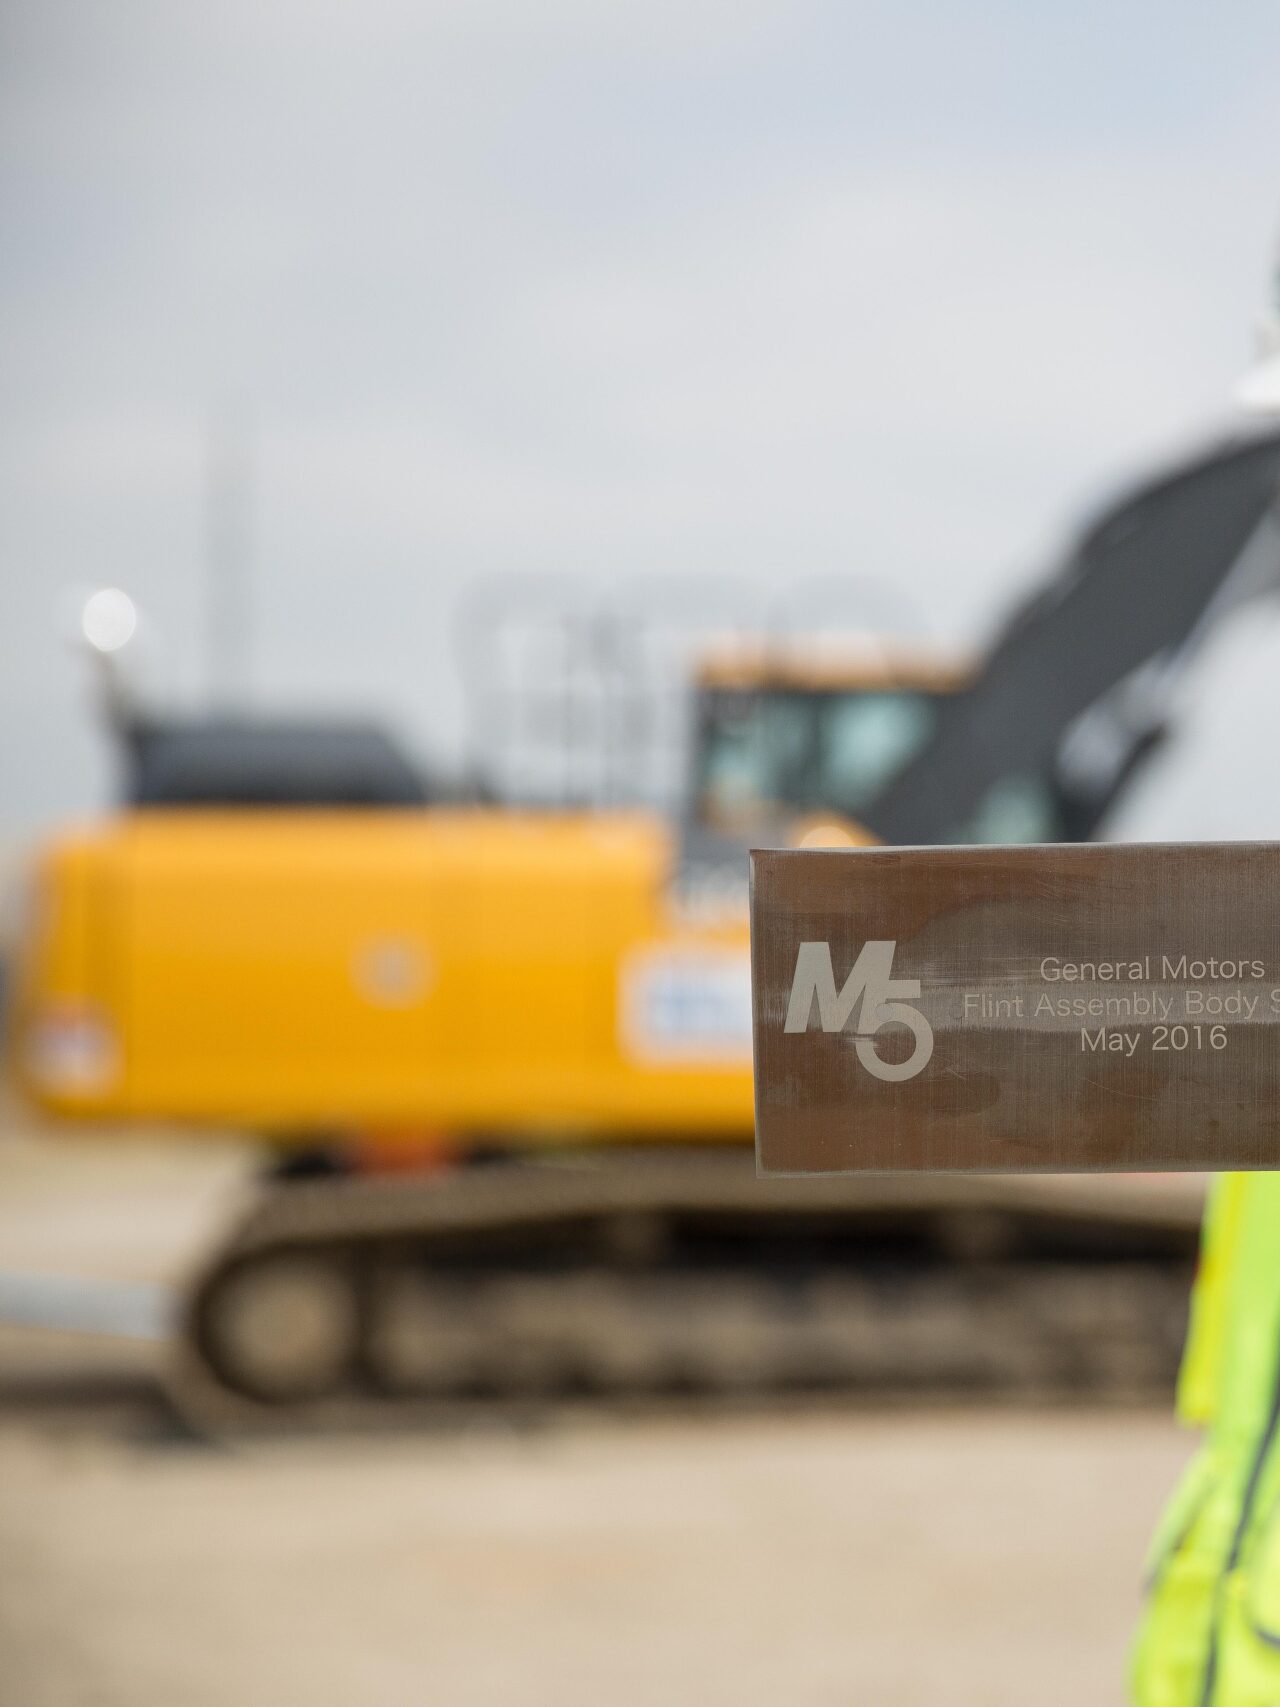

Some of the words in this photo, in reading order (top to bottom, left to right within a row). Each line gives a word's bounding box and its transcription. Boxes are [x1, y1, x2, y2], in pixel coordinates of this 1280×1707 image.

[1039, 956, 1151, 982] General
[1161, 954, 1266, 980] Motors
[784, 940, 934, 1082] M5
[962, 992, 1024, 1019] Flint
[1034, 991, 1174, 1020] Assembly
[1184, 989, 1260, 1020] Body
[1080, 1027, 1140, 1057] May
[1151, 1025, 1228, 1052] 2016
